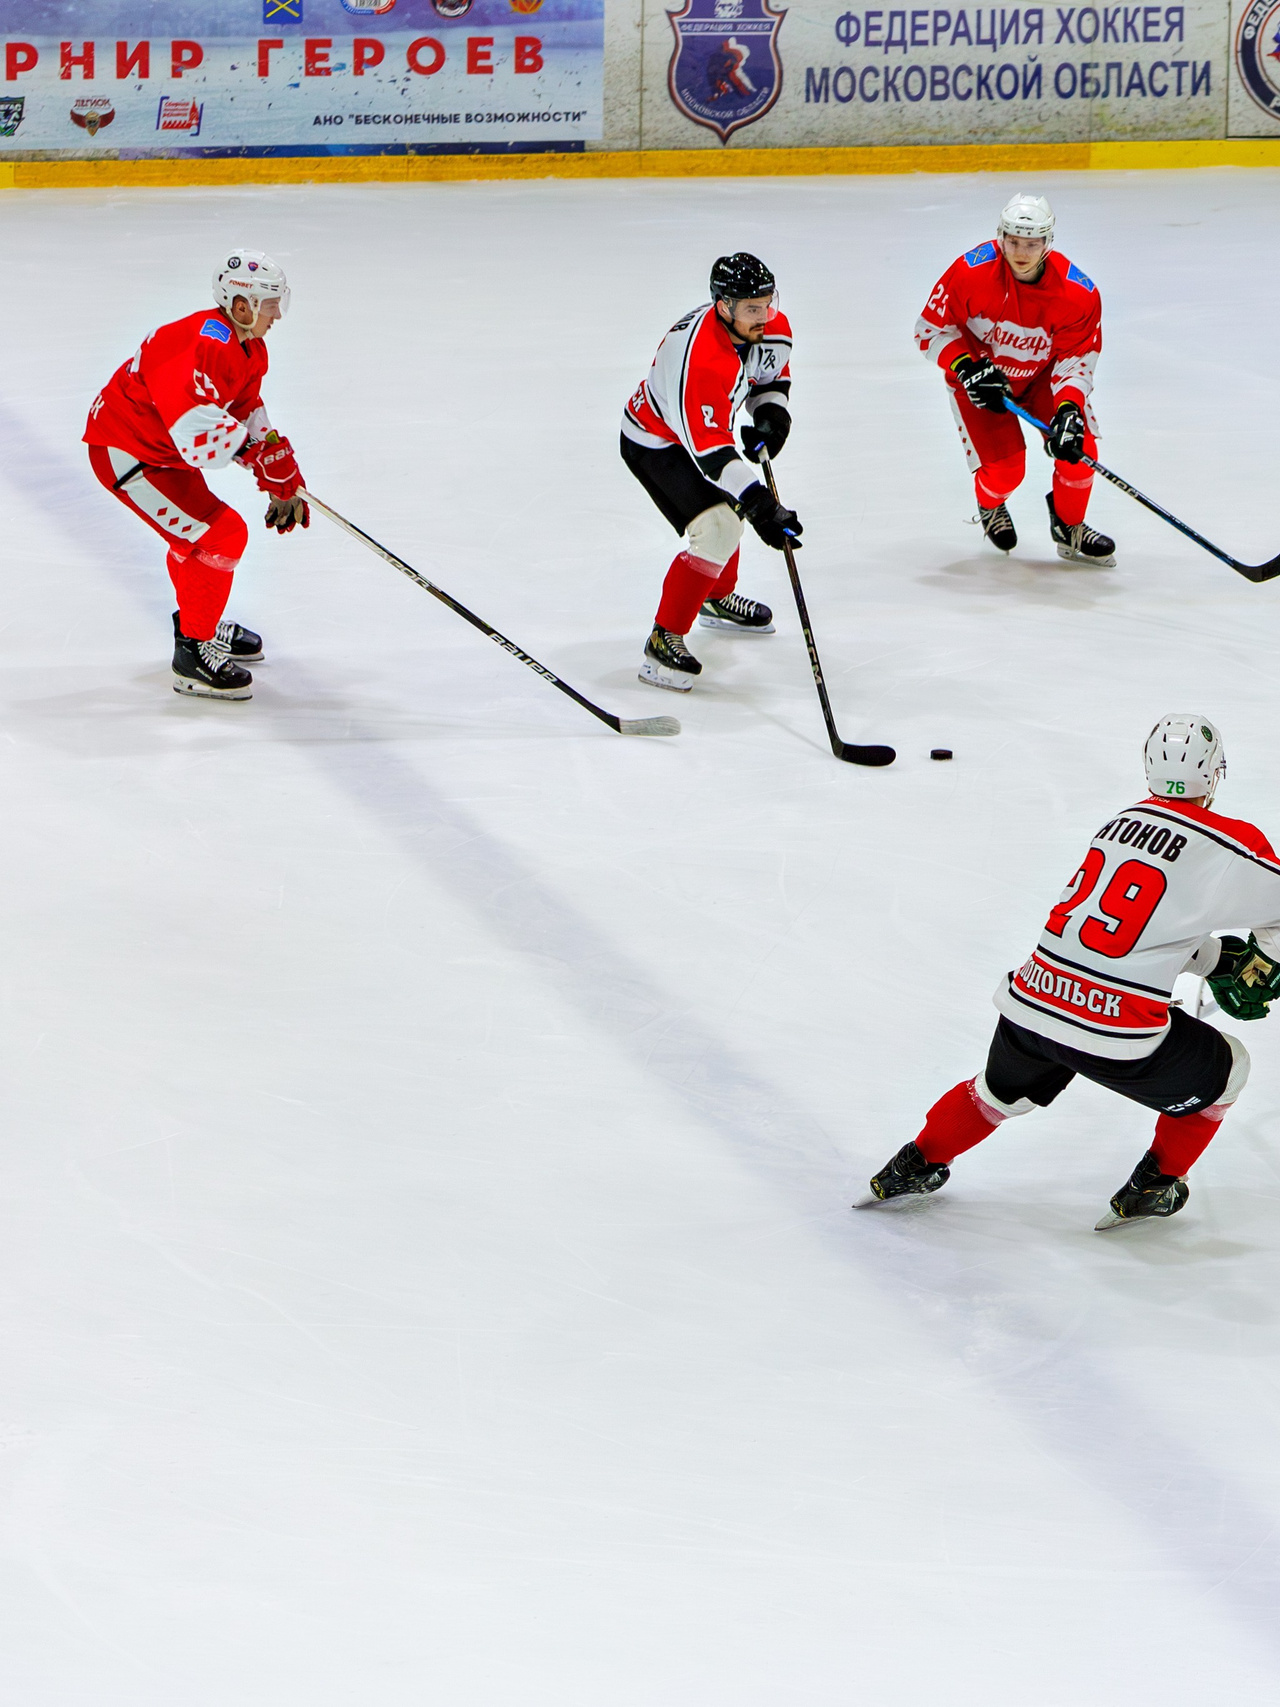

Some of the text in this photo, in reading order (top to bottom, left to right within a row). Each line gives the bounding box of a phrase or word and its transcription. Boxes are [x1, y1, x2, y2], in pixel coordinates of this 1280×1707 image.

[835, 6, 1185, 54] ФЕДЕРАЦИЯ ХОККЕЯ
[6, 37, 545, 80] РНИР ГЕРОЕВ
[805, 55, 1211, 103] МОСКОВСКОЙ ОБЛАСТИ
[313, 110, 587, 126] АНО "БЕСКОНЕЧНЫЕ ВОЗМОЖНОСТИ"
[229, 279, 253, 289] FONBET
[963, 364, 995, 389] CCM
[488, 632, 558, 683] BAUER
[1166, 780, 1186, 795] 76
[1092, 817, 1188, 863] НТОНОВ
[1045, 847, 1167, 959] 29
